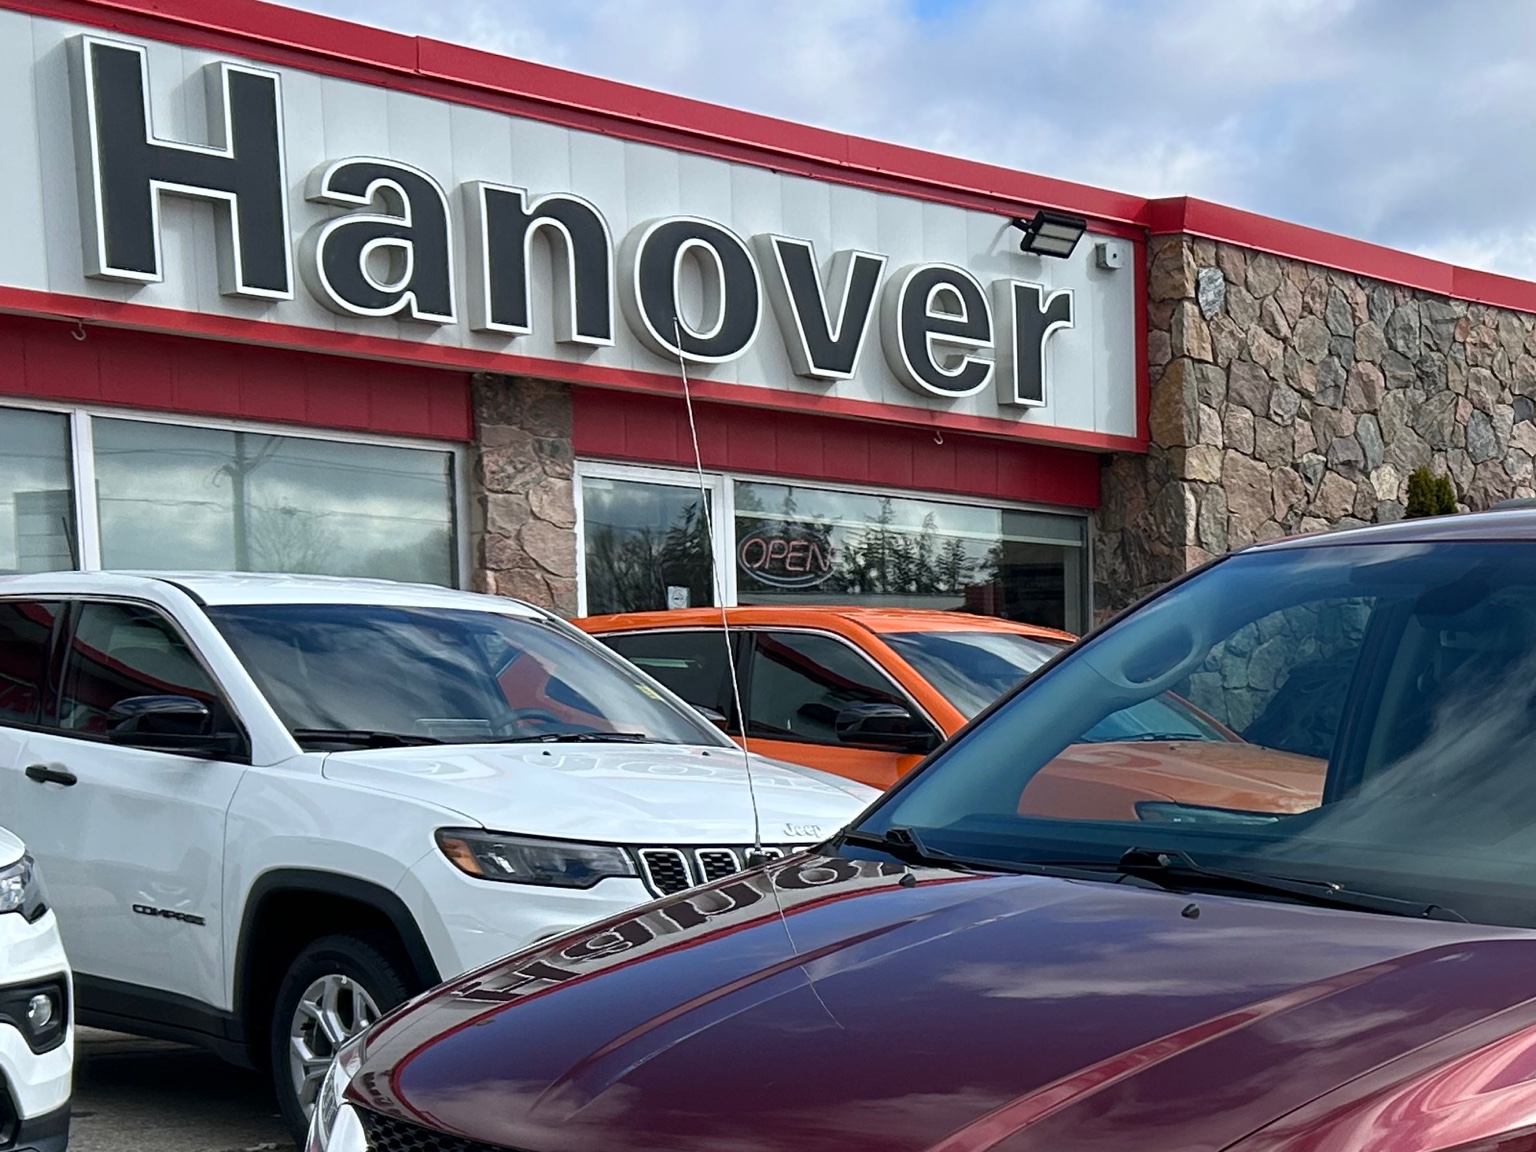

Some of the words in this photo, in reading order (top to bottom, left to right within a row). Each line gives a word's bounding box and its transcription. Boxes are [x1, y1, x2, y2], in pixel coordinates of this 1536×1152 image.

[67, 33, 1075, 408] Hanover
[742, 537, 831, 571] OPEN
[783, 823, 823, 838] Jeep
[132, 904, 206, 926] COMPASS
